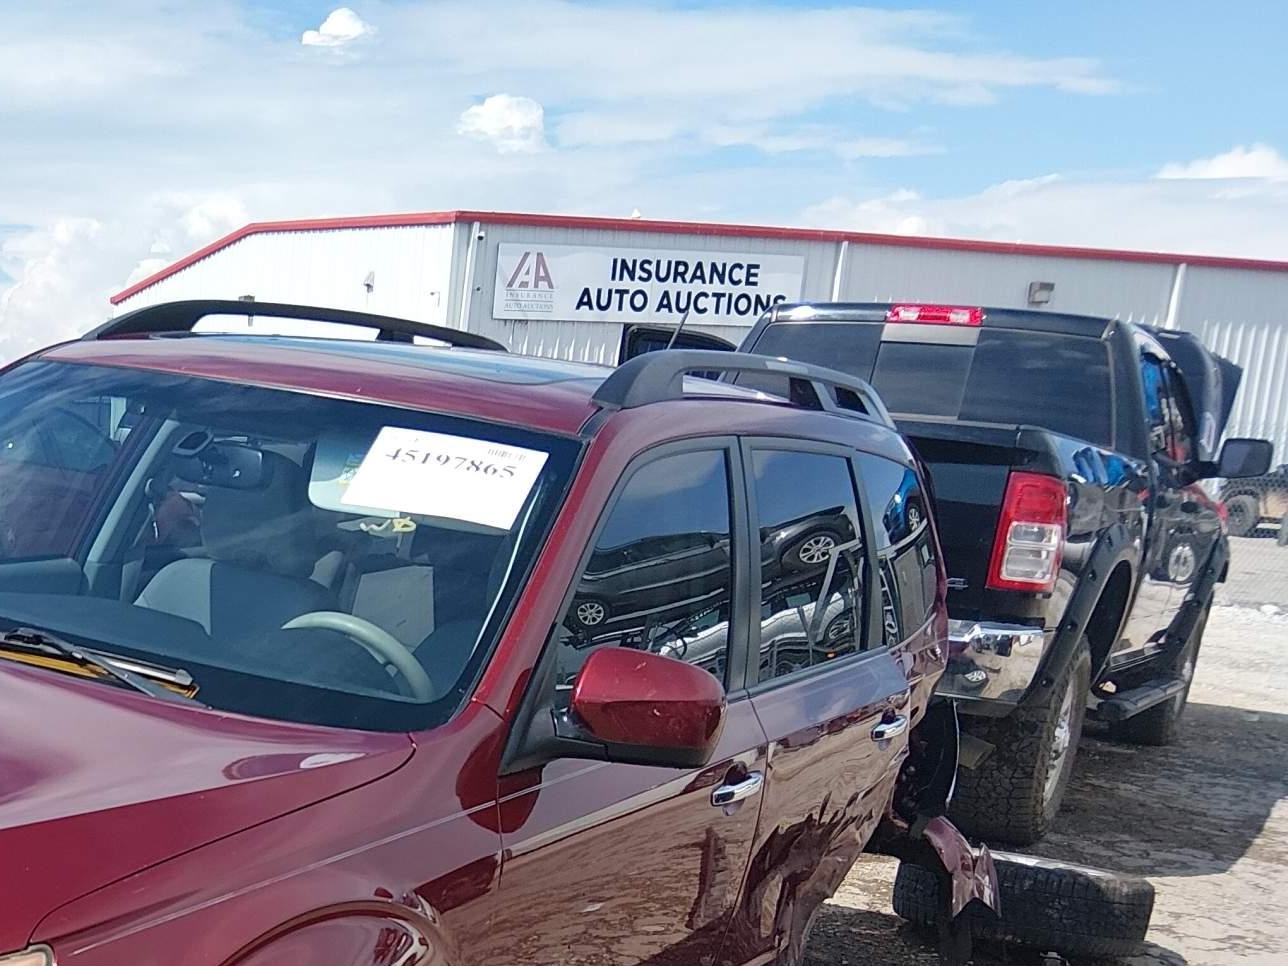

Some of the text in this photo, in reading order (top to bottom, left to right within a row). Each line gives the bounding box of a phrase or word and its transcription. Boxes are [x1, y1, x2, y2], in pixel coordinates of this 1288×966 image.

[610, 257, 761, 287] INSURANCE
[575, 287, 649, 313] AUTO
[385, 448, 517, 478] 45197865
